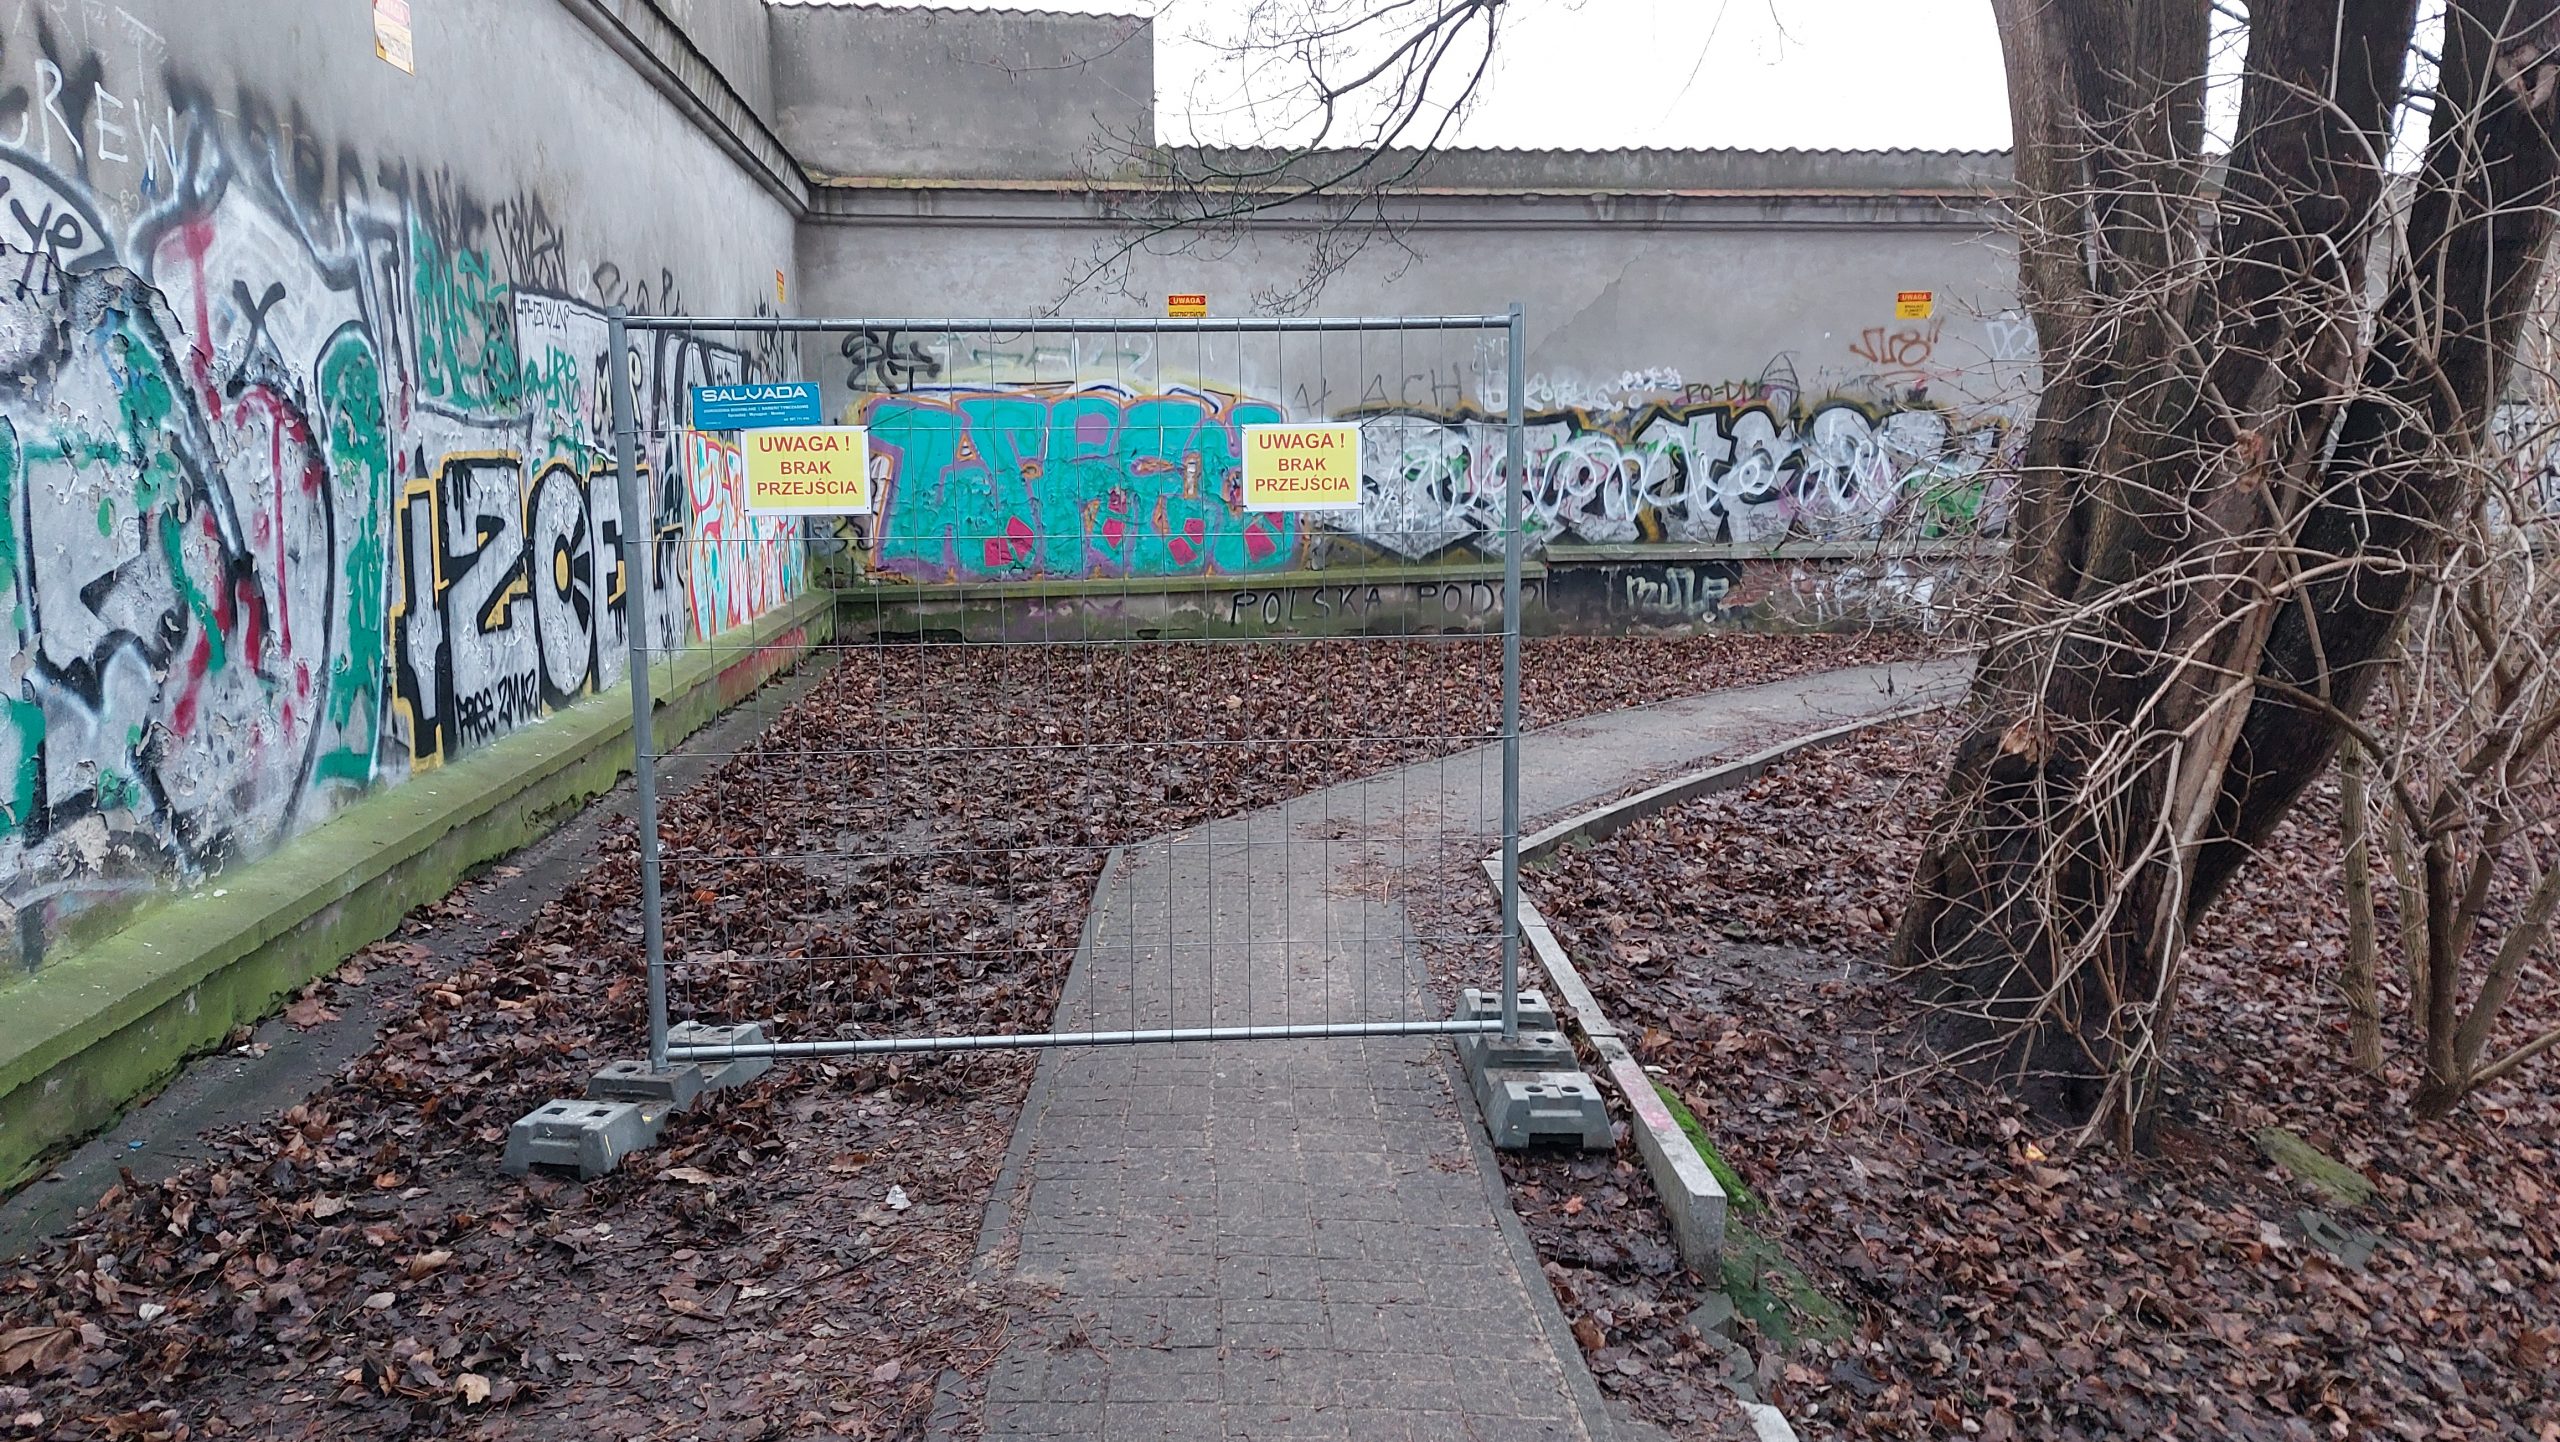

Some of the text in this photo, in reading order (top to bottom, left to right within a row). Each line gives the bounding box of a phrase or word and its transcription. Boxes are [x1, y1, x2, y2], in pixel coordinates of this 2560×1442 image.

[701, 386, 808, 402] SALVADA
[759, 435, 850, 452] UWAGA !
[1259, 433, 1345, 449] UWAGA !
[780, 461, 832, 475] BRAK
[1278, 458, 1327, 472] BRAK
[757, 478, 857, 496] PRZEJŚCIA
[1255, 475, 1350, 492] PRZEJŚCIA
[1230, 586, 1382, 627] POLSKA
